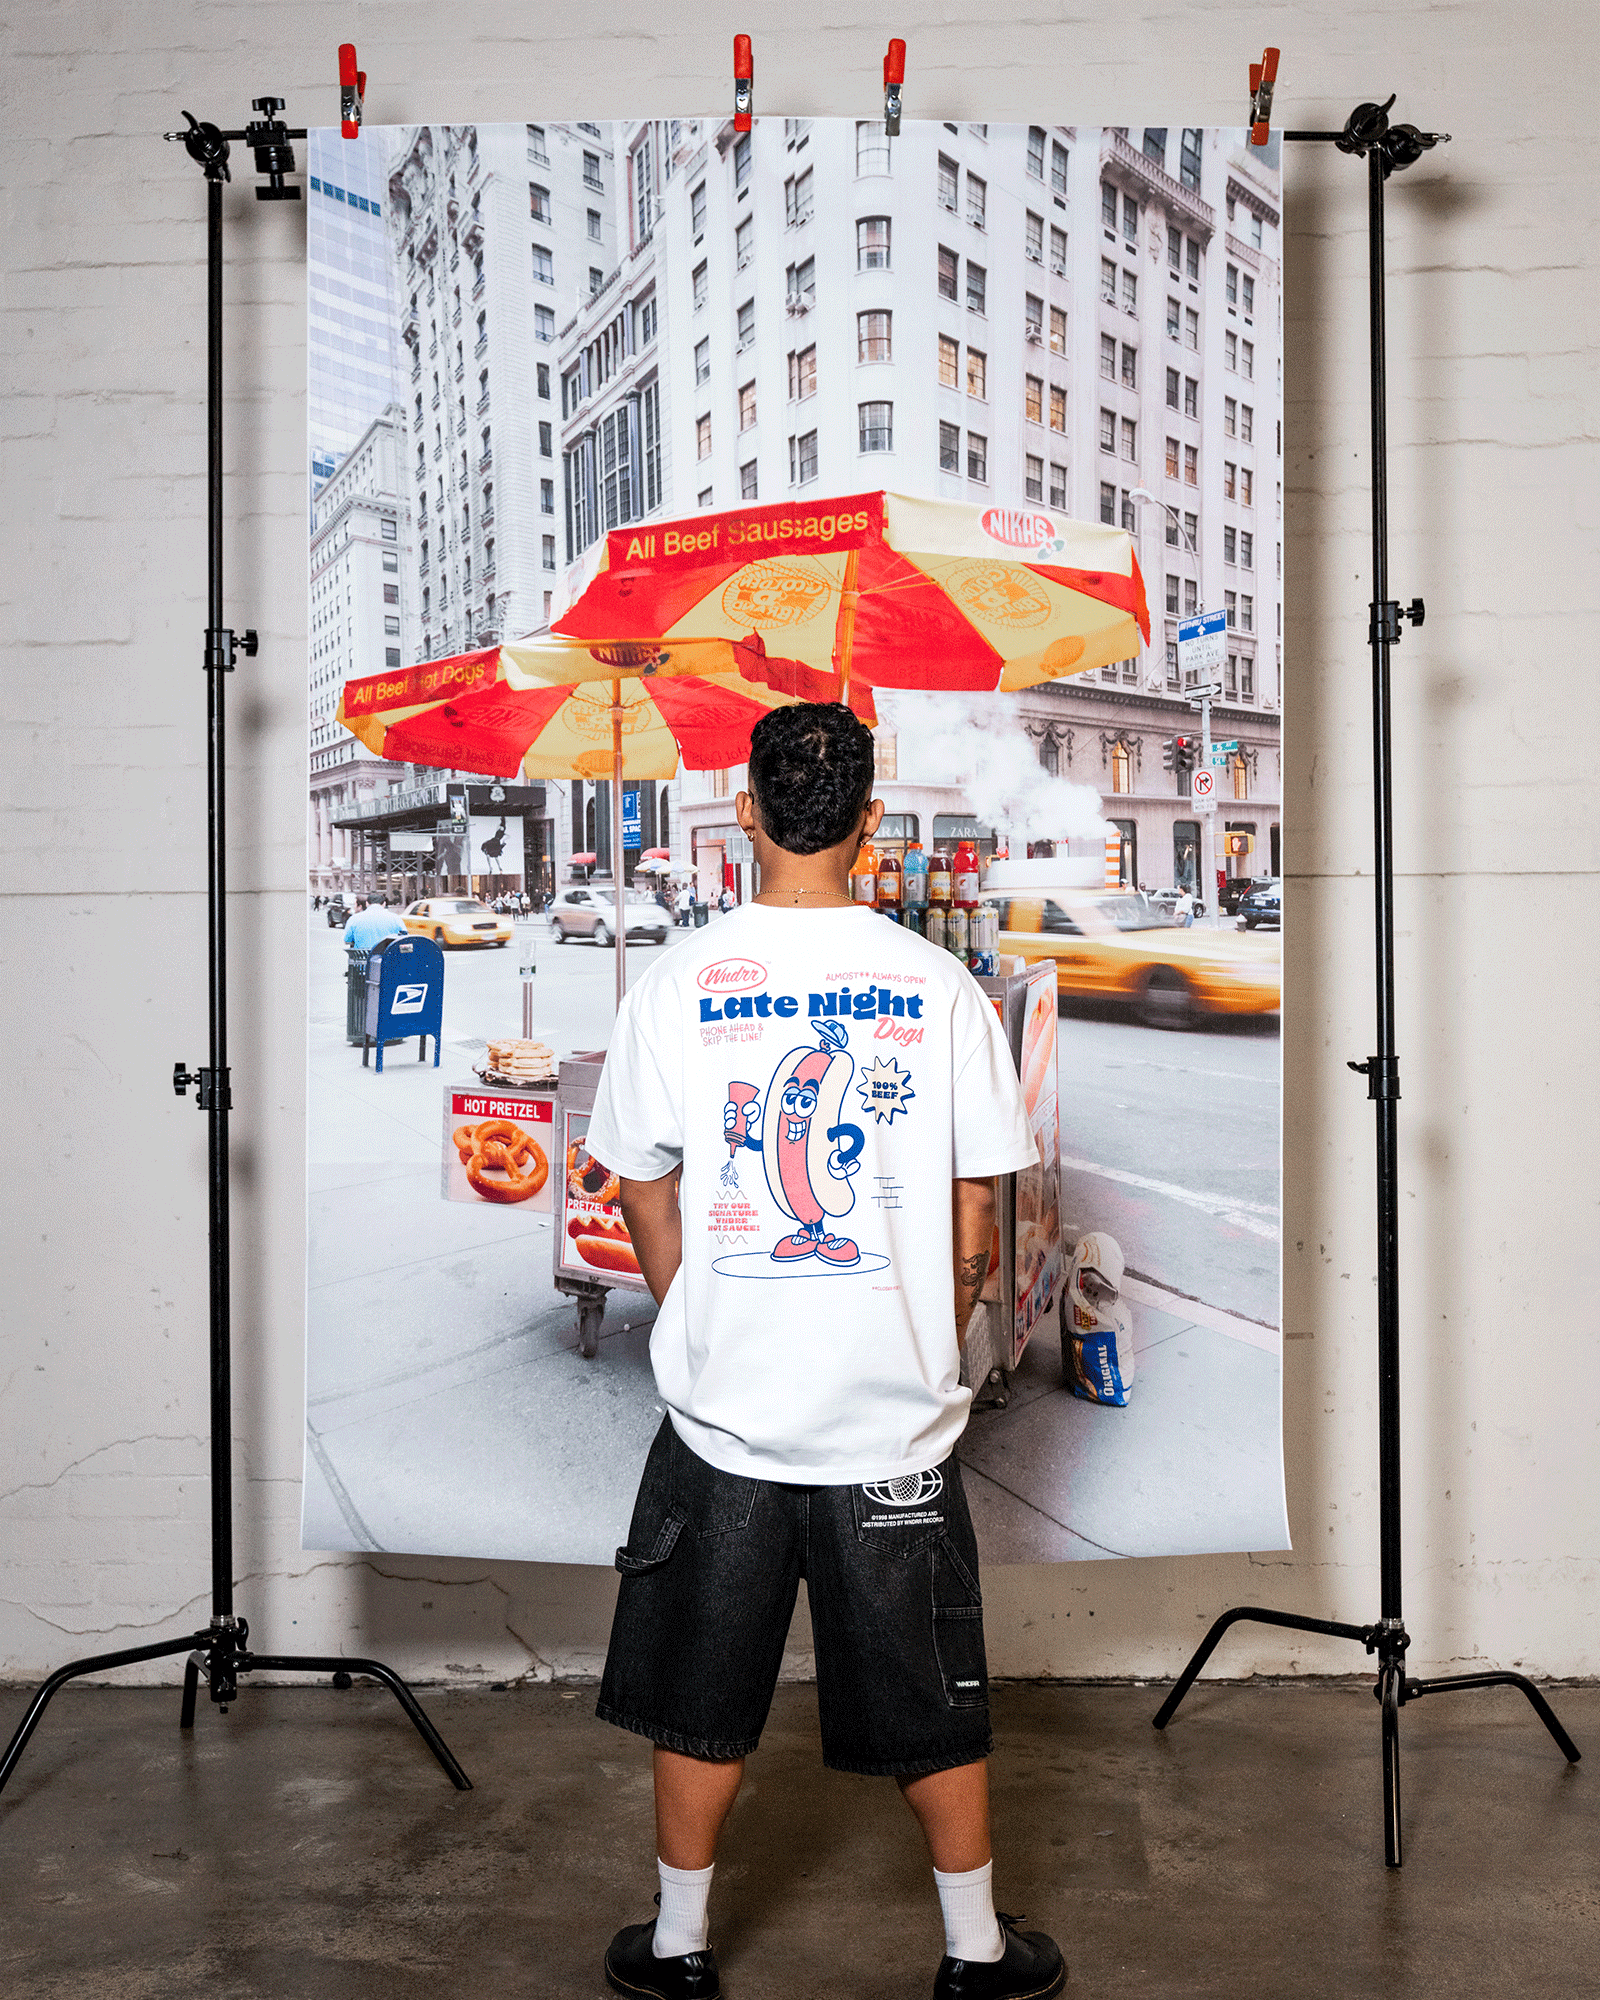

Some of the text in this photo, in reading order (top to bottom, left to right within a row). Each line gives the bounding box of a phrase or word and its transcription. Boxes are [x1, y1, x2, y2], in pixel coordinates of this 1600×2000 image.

[990, 508, 1048, 547] NIKAS
[626, 535, 655, 560] All
[664, 524, 718, 556] Beef
[1202, 612, 1224, 625] STREET
[353, 685, 373, 705] All
[376, 676, 409, 700] Beef
[441, 662, 485, 685] Dogs
[873, 826, 903, 838] ARA
[950, 826, 979, 838] ZARA
[704, 966, 760, 985] Wndrr
[872, 972, 902, 983] ALWAYS
[903, 975, 927, 985] OPEN!
[699, 985, 923, 1023] Late Night
[699, 1022, 764, 1039] PHONE AHEAD &
[873, 1016, 925, 1047] Dogs
[702, 1031, 762, 1047] SKIP THE LINE!
[872, 1081, 898, 1091] 100%
[871, 1090, 899, 1100] BEEF
[464, 1099, 541, 1119] HOT PRETZEL
[567, 1199, 605, 1215] PRETZEL
[1098, 1344, 1115, 1396] ORIGINAL
[861, 1520, 896, 1528] DISTRIBUTED
[922, 1516, 944, 1524] RECORDS
[888, 1511, 927, 1519] MANUFACTURED
[955, 1680, 980, 1688] WNDRR
